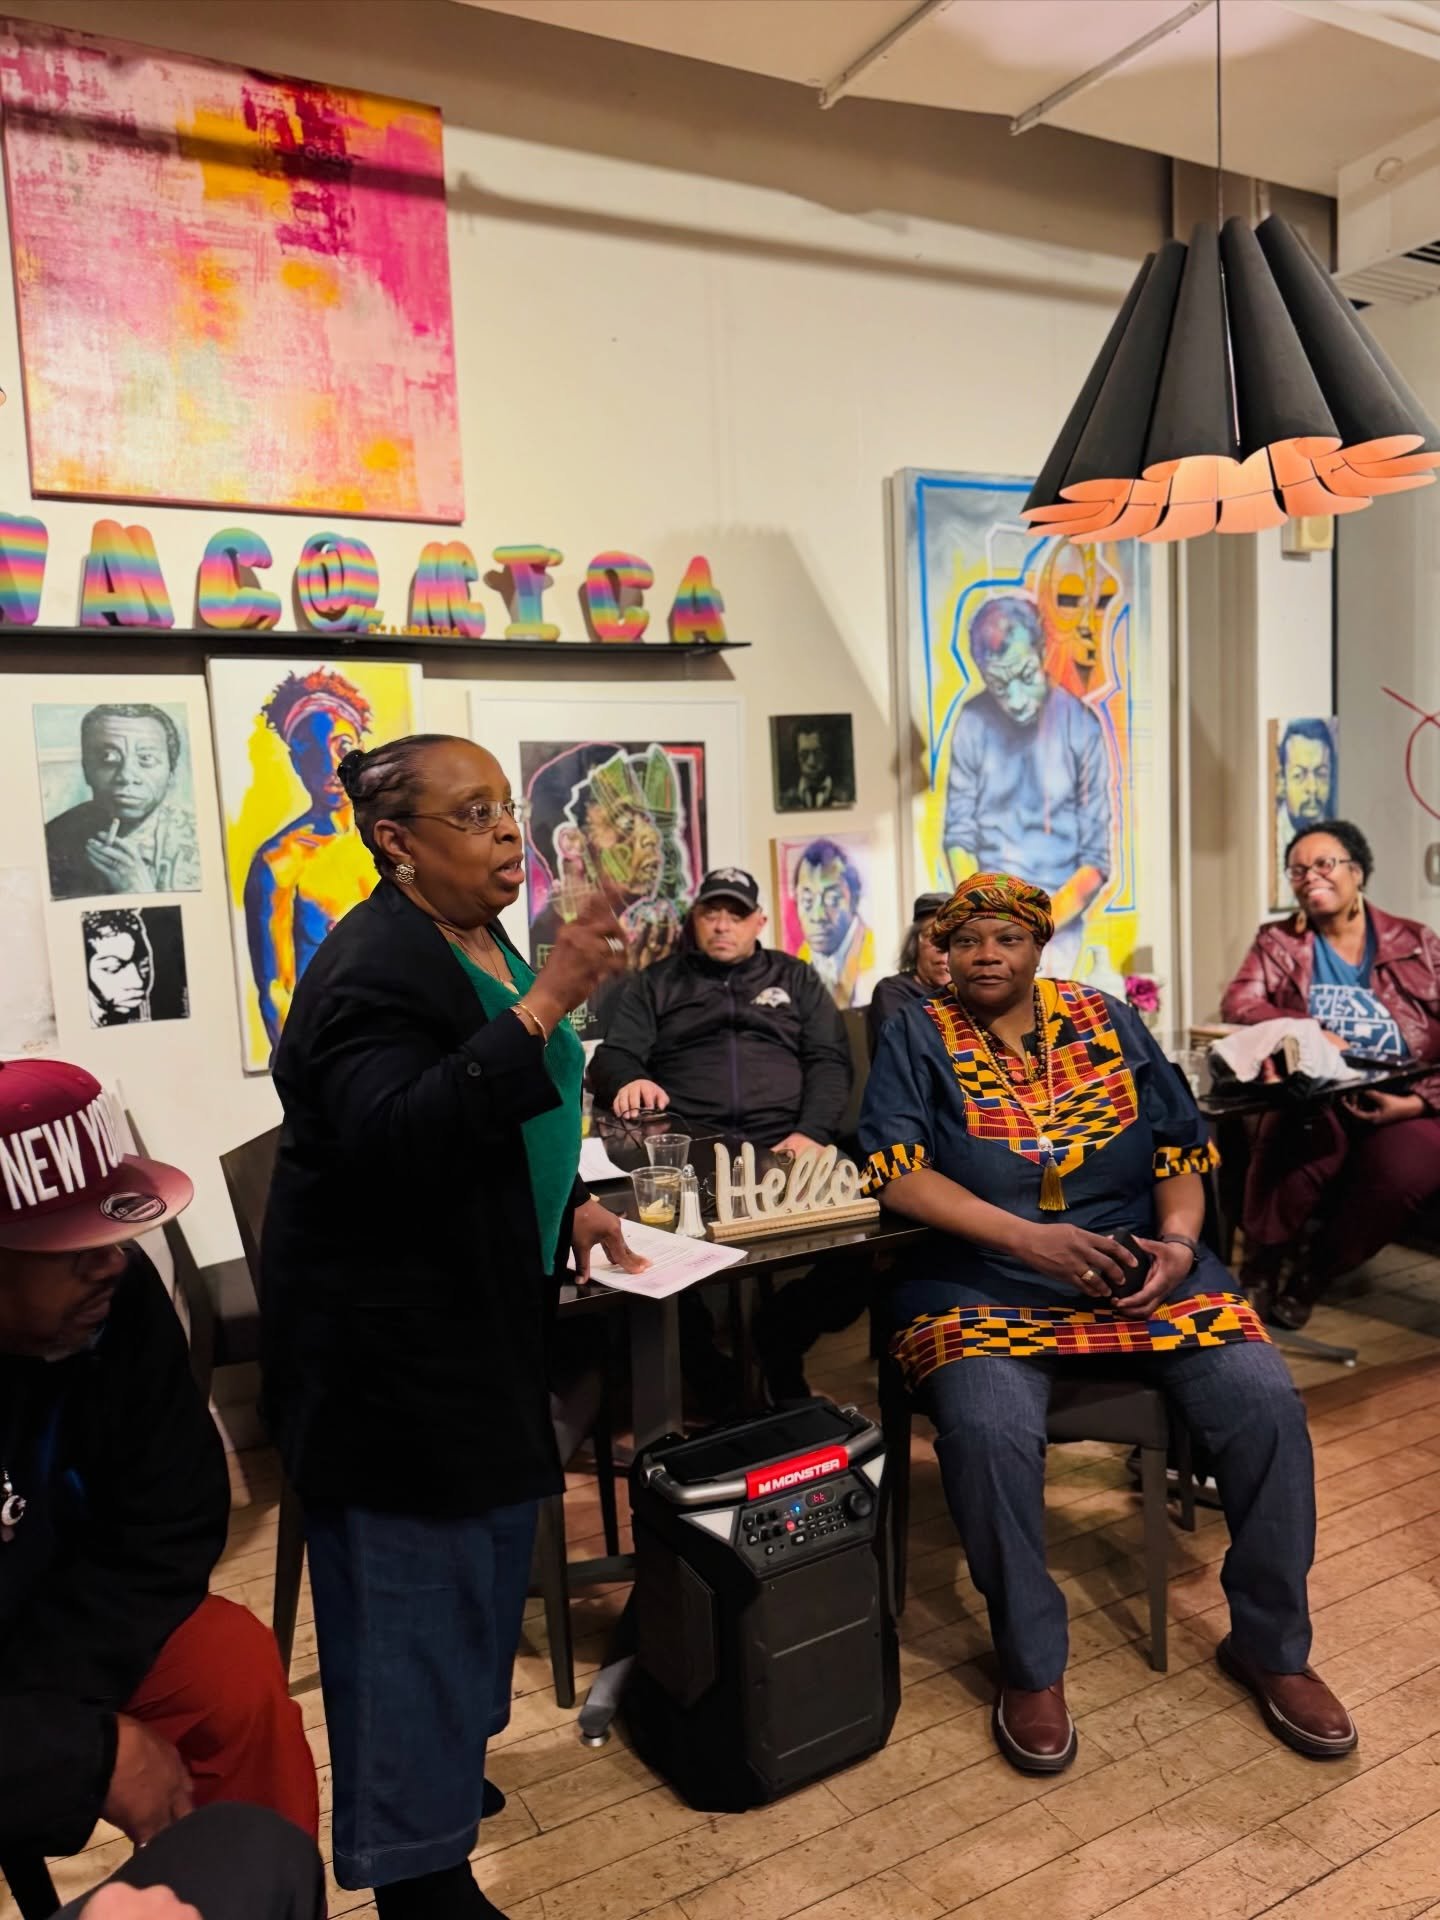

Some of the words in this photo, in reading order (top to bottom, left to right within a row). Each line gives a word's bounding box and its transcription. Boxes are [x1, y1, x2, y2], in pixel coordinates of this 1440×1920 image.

[0, 1114, 86, 1211] NEW
[76, 1089, 125, 1179] YO
[714, 1141, 871, 1224] Hello
[771, 1458, 840, 1490] MONSTER
